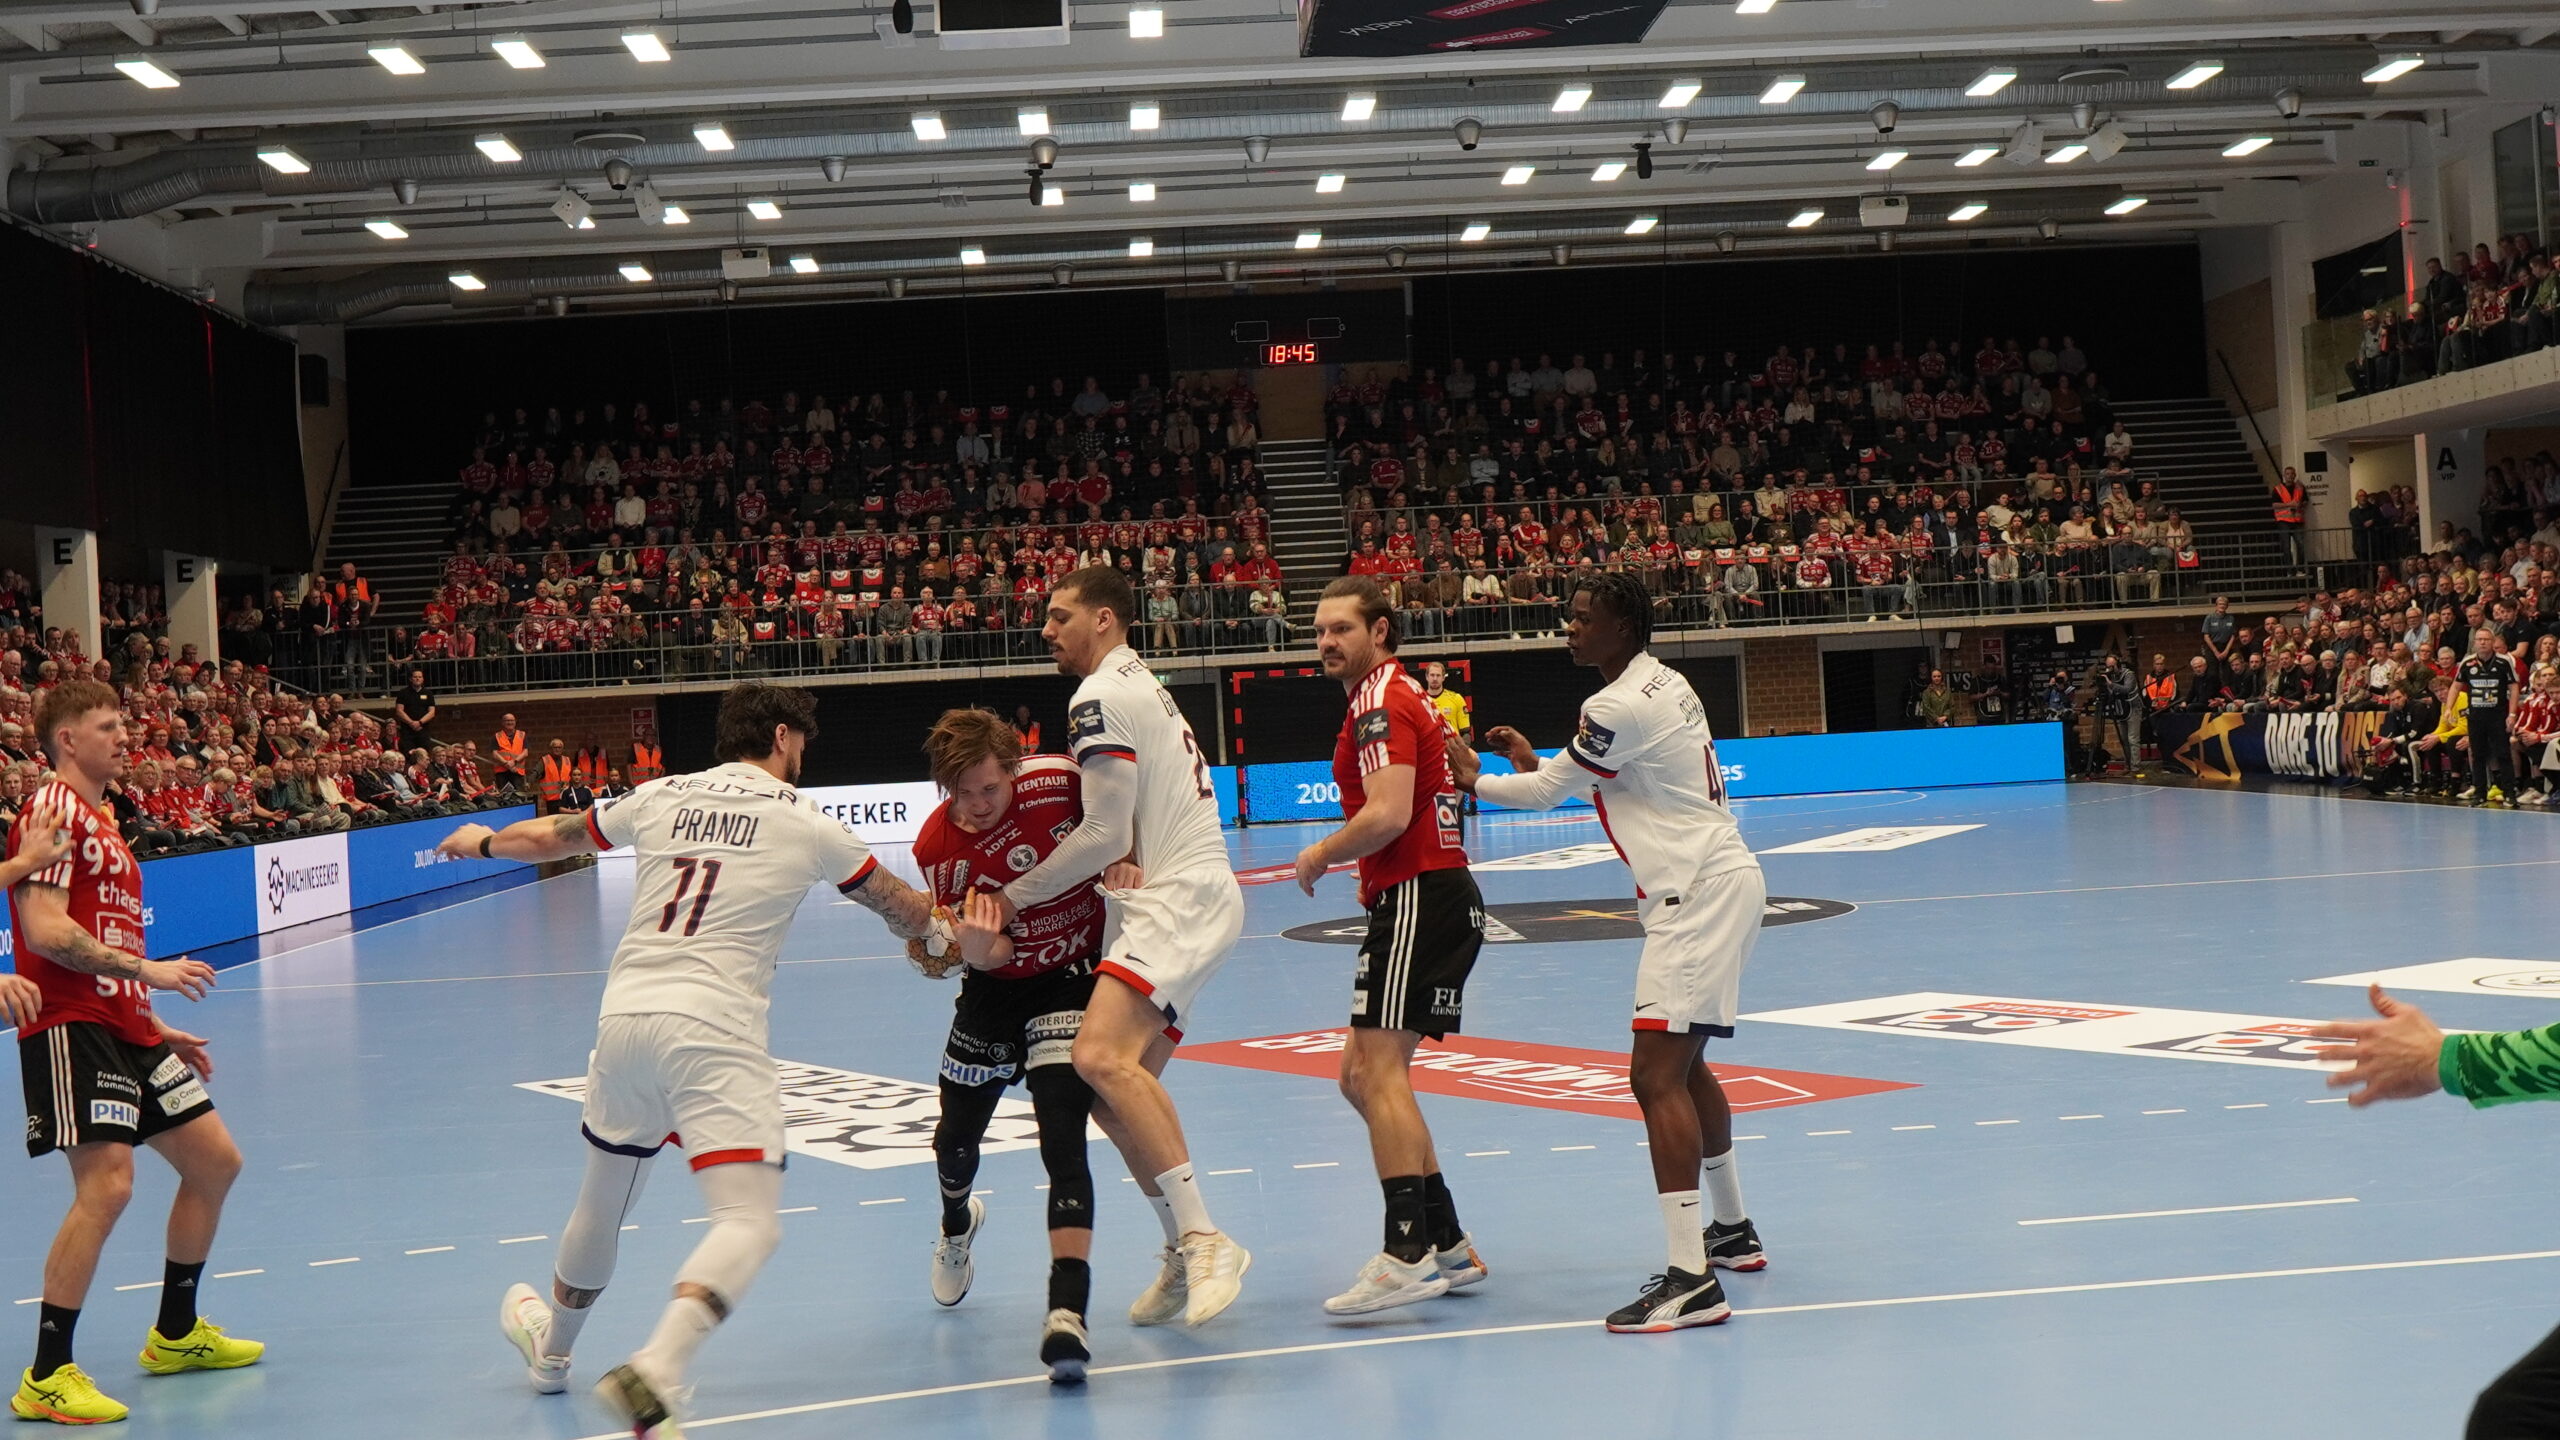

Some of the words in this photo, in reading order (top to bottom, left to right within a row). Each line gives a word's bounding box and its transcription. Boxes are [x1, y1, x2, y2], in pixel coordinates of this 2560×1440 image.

[1269, 343, 1315, 363] 18:45
[2437, 448, 2457, 470] A
[53, 538, 73, 564] E
[176, 559, 194, 582] E
[2265, 713, 2314, 776] DARE
[2315, 711, 2339, 777] TO
[1017, 776, 1068, 794] KENTAUR
[1026, 796, 1068, 809] Christensen
[671, 808, 759, 848] PRANDI
[285, 862, 340, 894] MACHINESEEKER
[658, 857, 722, 936] 71
[1031, 896, 1091, 927] MIDDELFART
[1031, 905, 1092, 936] SPAREKASSE
